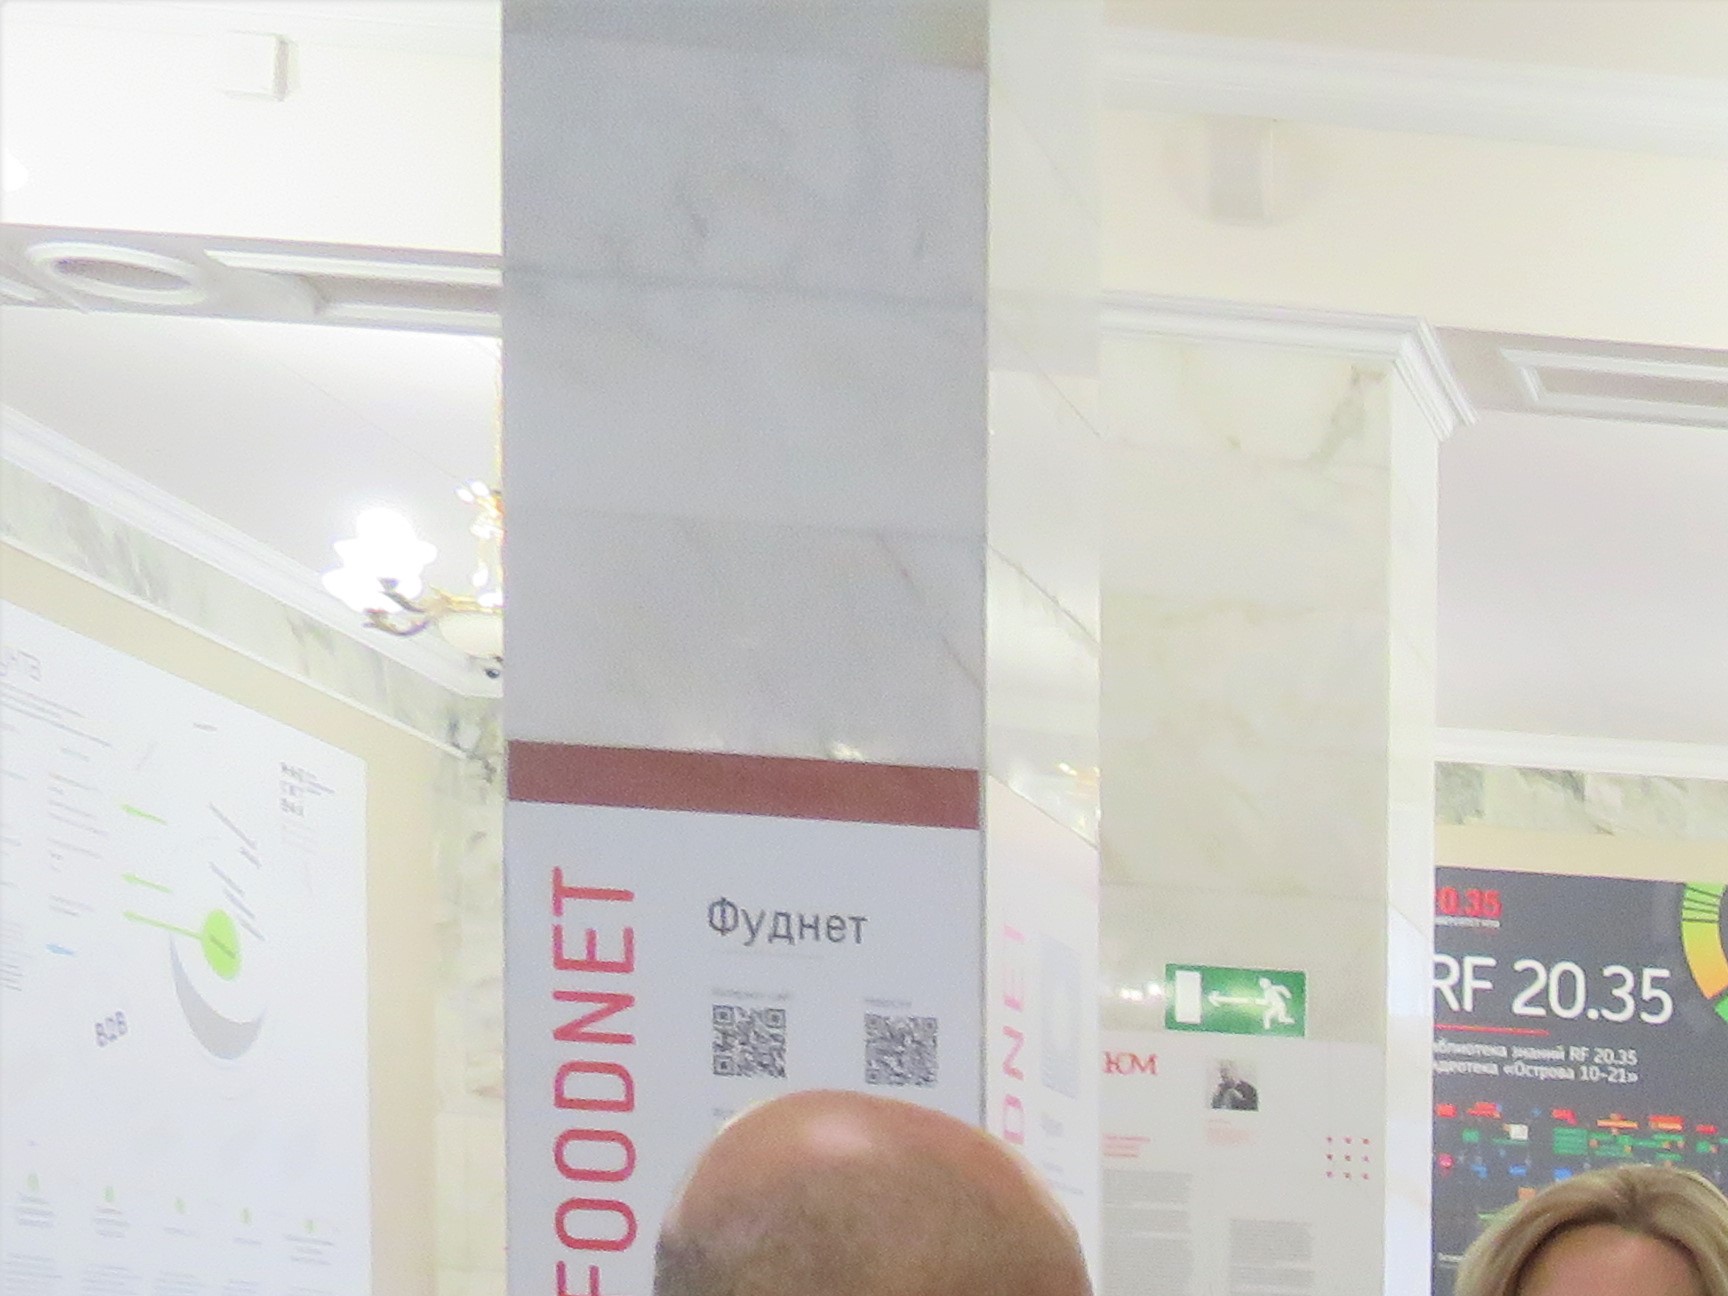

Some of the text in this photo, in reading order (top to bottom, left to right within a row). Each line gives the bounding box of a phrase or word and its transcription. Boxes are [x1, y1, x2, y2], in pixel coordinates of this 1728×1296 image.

[707, 897, 868, 946] Фуднет
[1432, 954, 1674, 1026] RF 20.35
[1593, 1047, 1638, 1066] 20.35
